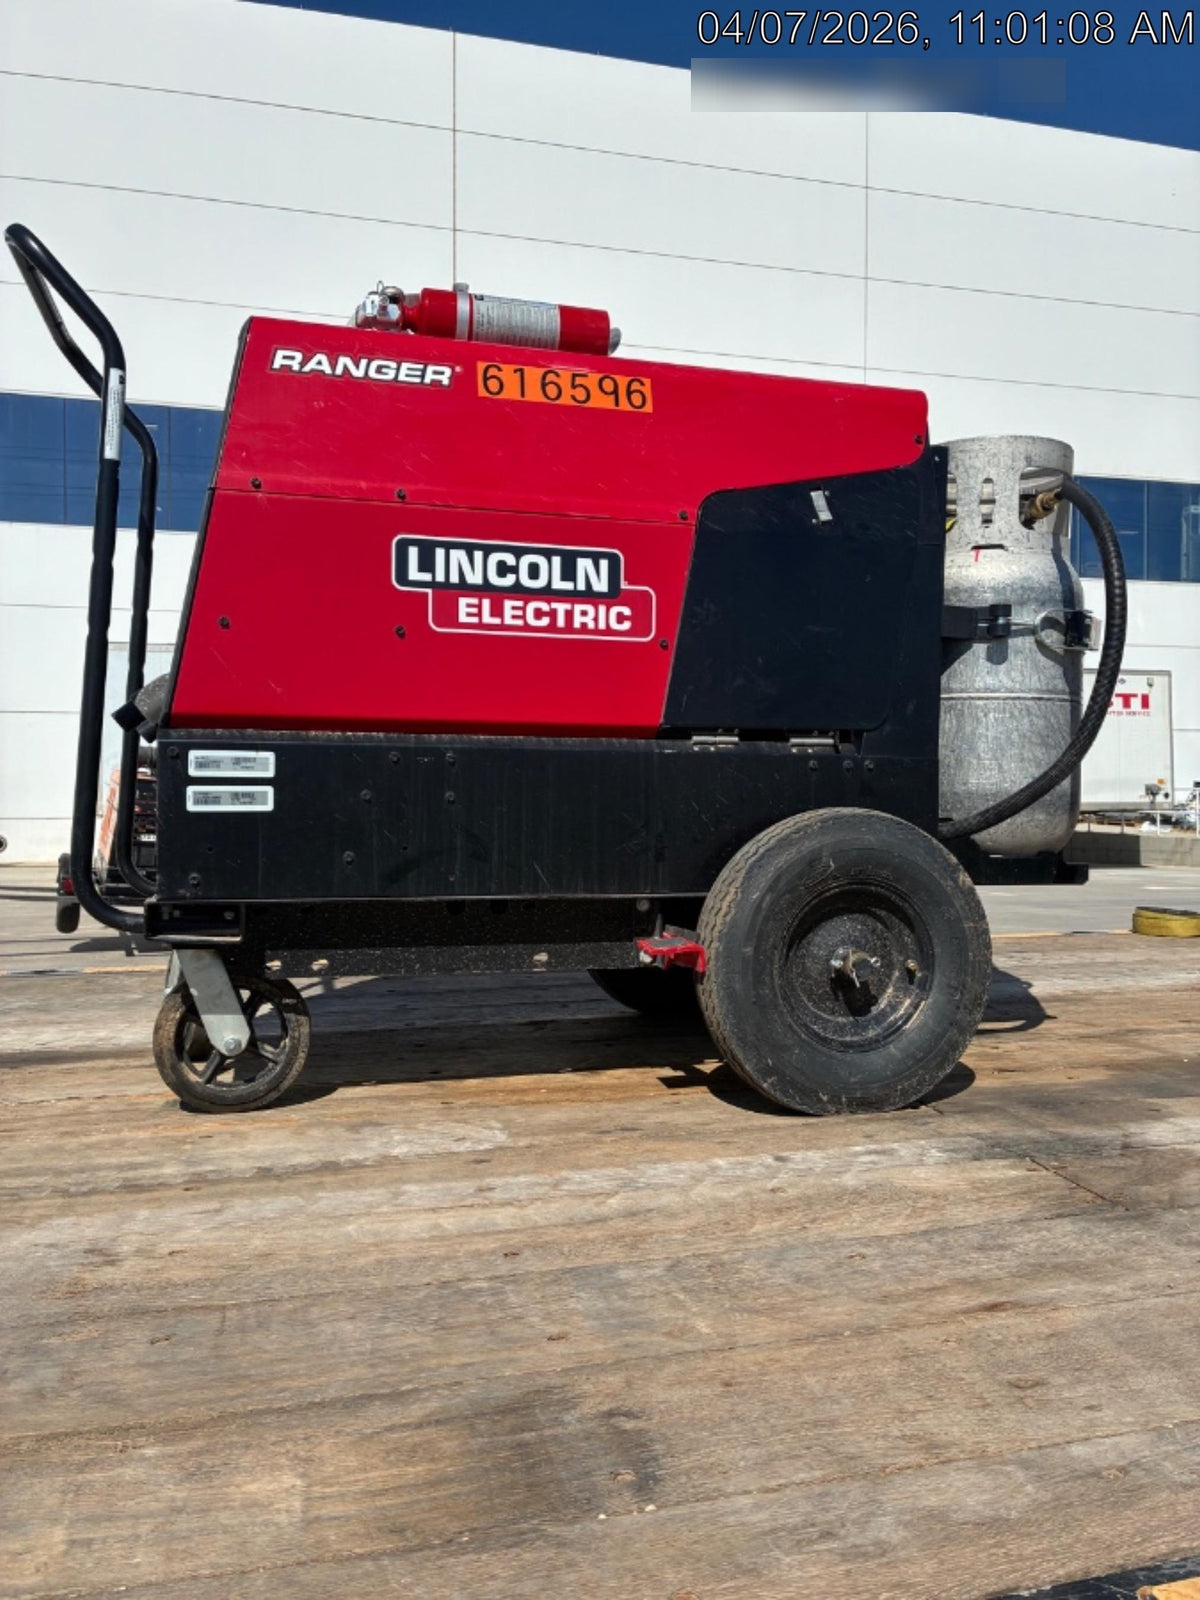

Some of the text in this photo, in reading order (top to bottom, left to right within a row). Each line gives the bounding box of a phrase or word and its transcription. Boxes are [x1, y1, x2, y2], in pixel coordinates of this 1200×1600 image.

[271, 348, 453, 386] RANGER
[482, 363, 648, 410] 616596
[406, 544, 609, 594] LINCOLN
[457, 596, 633, 632] ELECTRIC
